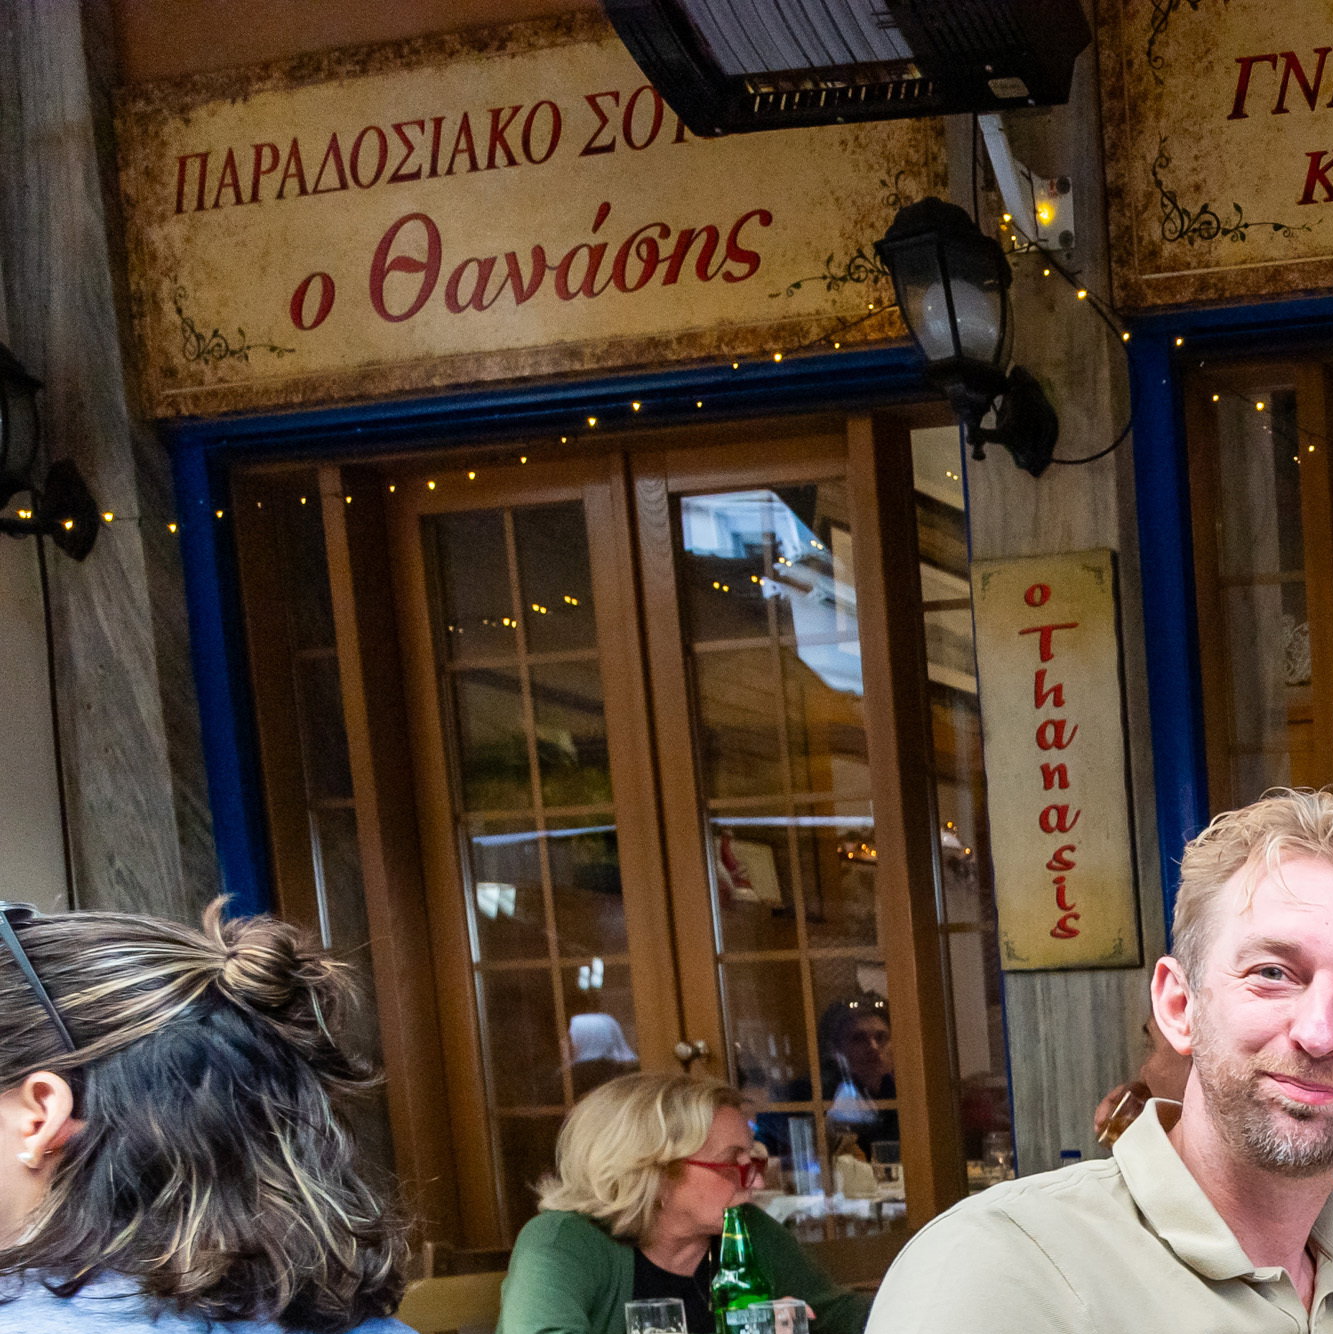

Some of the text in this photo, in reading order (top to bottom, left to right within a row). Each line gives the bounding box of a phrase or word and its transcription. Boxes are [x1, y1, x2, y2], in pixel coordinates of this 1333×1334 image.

[173, 99, 563, 216] ΠΑΡΑΔΟΣΙΑΚΟ
[367, 201, 776, 326] Θανάσης
[1018, 621, 1082, 940] Thanasis
